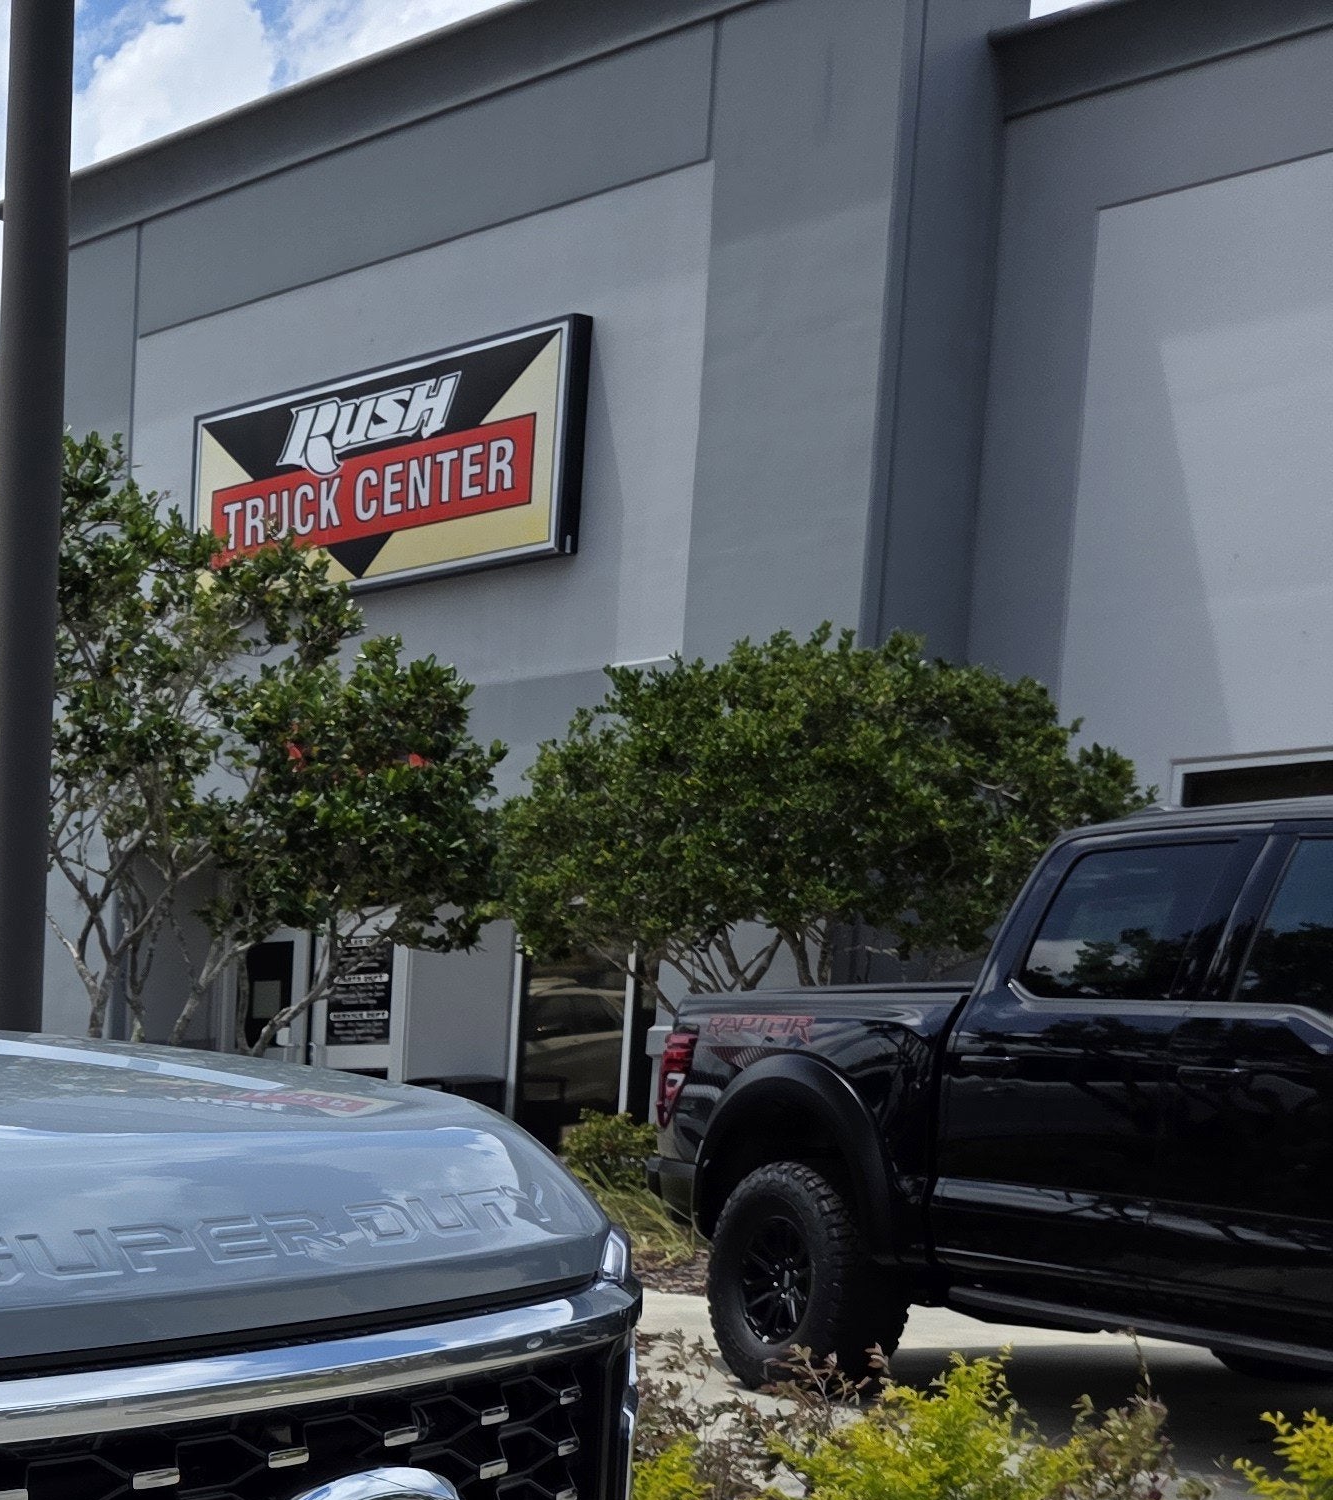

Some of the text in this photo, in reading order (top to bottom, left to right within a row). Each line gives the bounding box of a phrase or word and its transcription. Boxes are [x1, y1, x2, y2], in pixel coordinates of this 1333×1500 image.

[276, 371, 462, 477] RUSH
[223, 437, 515, 550] TRUCK CENTER
[706, 1014, 816, 1046] RAPTOR
[343, 1183, 553, 1248] DUTY
